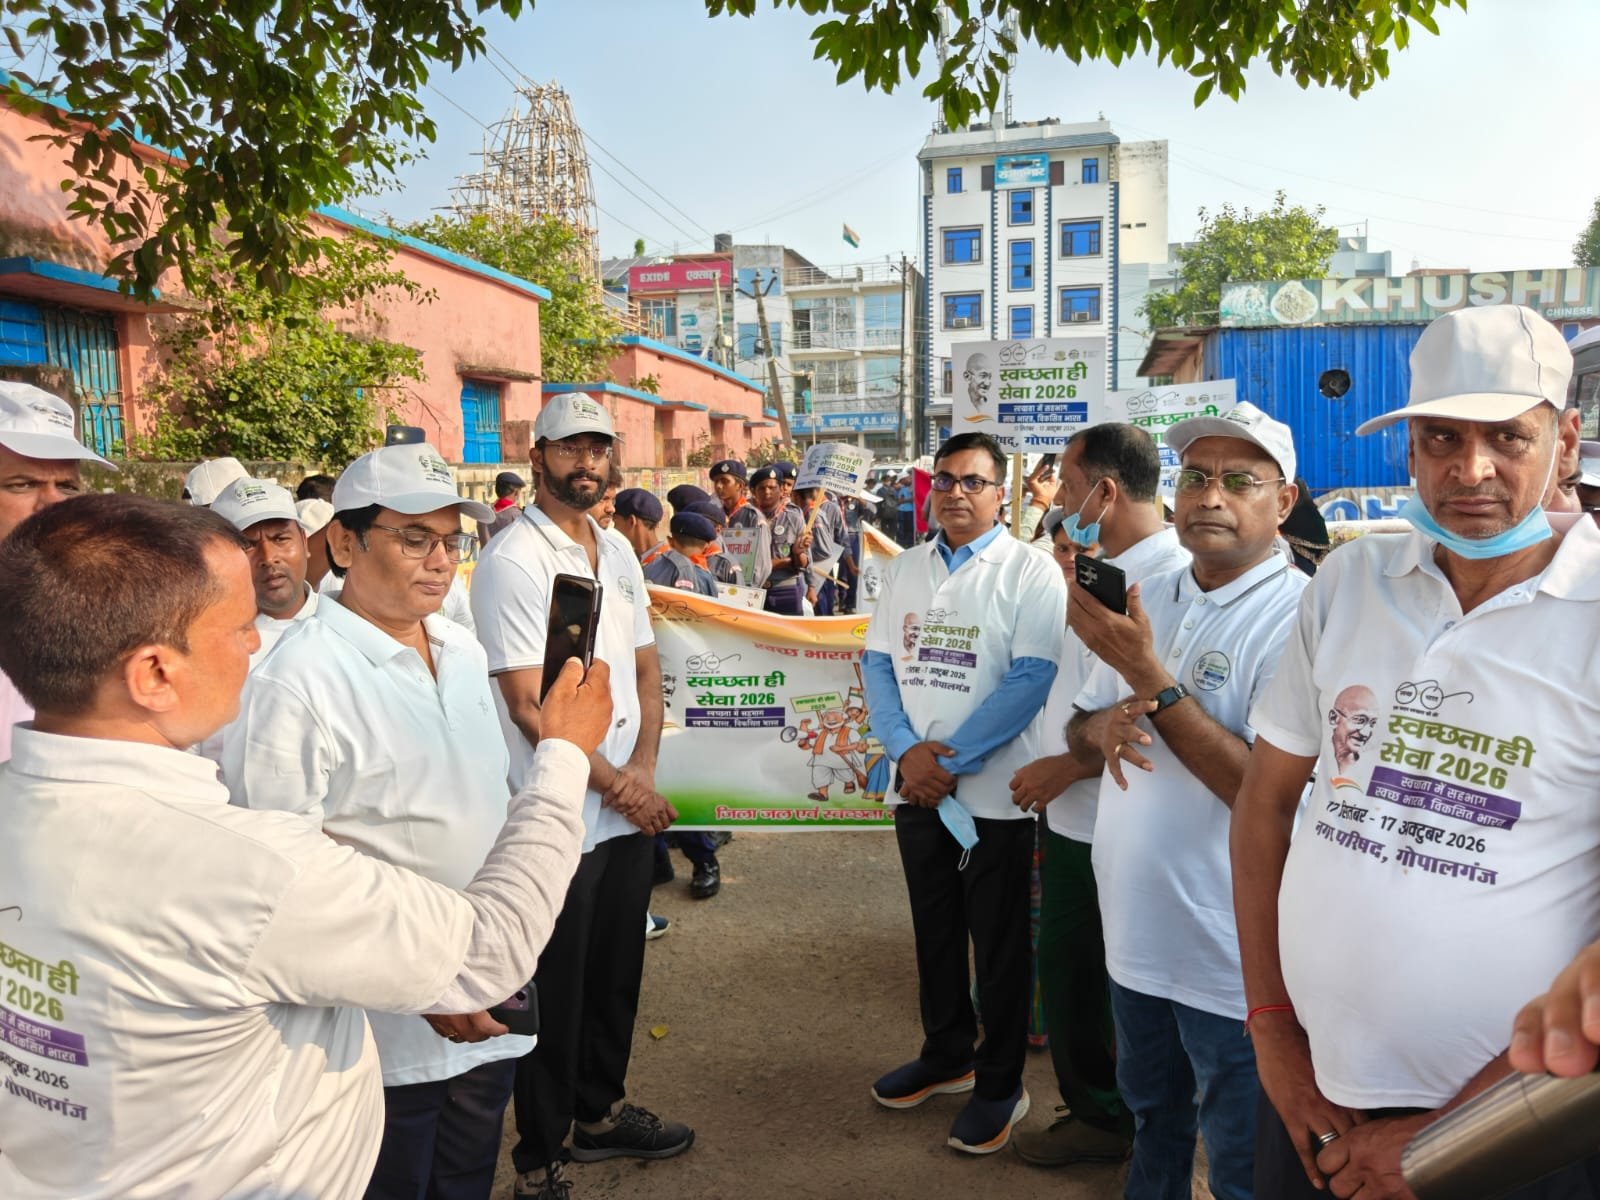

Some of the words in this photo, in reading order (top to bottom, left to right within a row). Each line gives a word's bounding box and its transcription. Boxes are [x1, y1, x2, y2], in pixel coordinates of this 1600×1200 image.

[640, 272, 670, 282] EXIDE
[1320, 270, 1584, 313] KHUSHI
[1546, 307, 1592, 317] CHINESE
[999, 367, 1064, 381] स्वच्छता
[1066, 361, 1088, 380] ही
[998, 383, 1032, 400] सेवा
[1035, 385, 1077, 399] 2026
[880, 416, 899, 425] KHA
[1024, 434, 1072, 446] गोपाल
[923, 624, 965, 637] स्वच्छता
[966, 626, 981, 639] ही
[921, 634, 944, 647] सेवा
[945, 638, 972, 650] 2026
[804, 648, 854, 660] भारत
[686, 676, 760, 688] स्वच्छता
[763, 670, 786, 688] ही
[950, 670, 966, 680] 2026
[930, 678, 970, 693] गोपालगंज
[696, 691, 736, 706] सेवा
[740, 693, 776, 706] 2026
[1388, 714, 1494, 755] स्वच्छता
[1494, 736, 1536, 768] ही
[1380, 738, 1434, 772] सेवा
[1436, 752, 1508, 790] 2026
[1374, 786, 1400, 802] स्वच्छ
[1402, 794, 1426, 810] भारत,
[1430, 798, 1475, 821] विकसित
[1434, 782, 1444, 795] में
[1446, 787, 1487, 808] सहभाग
[716, 806, 756, 820] जिला
[759, 808, 792, 820] जल
[794, 806, 820, 820] एवं
[823, 808, 884, 820] स्वच्छता
[1380, 815, 1398, 832] 17
[1446, 833, 1486, 854] 2026
[1396, 846, 1499, 886] गोपालगंज
[46, 960, 80, 996] ही
[7, 978, 64, 1022] 2026
[48, 1046, 77, 1064] भारत
[33, 1067, 70, 1090] 2026
[4, 1076, 88, 1120] गोपालगंज
